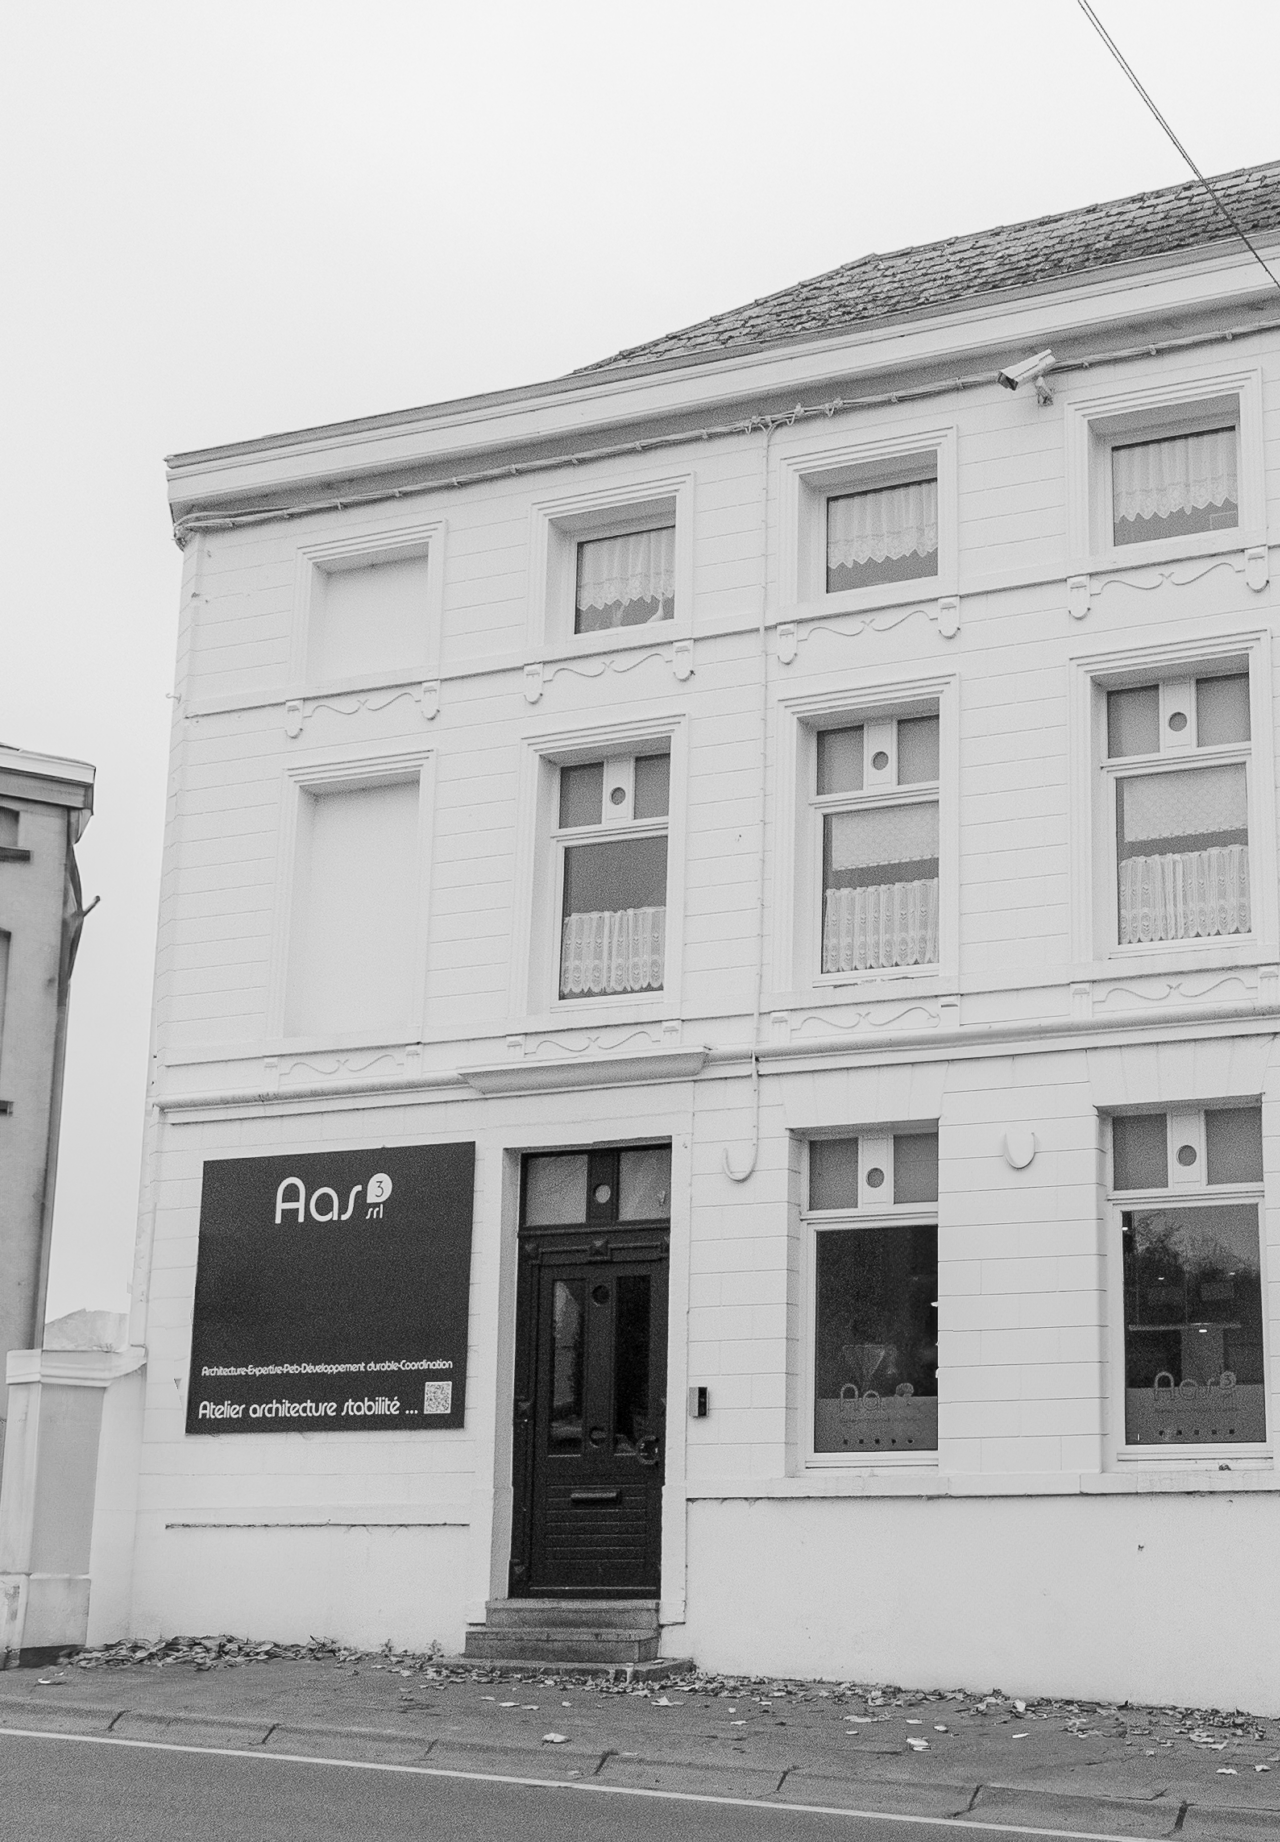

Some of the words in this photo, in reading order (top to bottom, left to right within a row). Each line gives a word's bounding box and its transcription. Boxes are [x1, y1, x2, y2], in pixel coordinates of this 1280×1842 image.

[365, 1204, 384, 1219] srl
[198, 1400, 246, 1419] Atelier
[249, 1399, 338, 1418] architecture
[341, 1396, 400, 1416] stabilité
